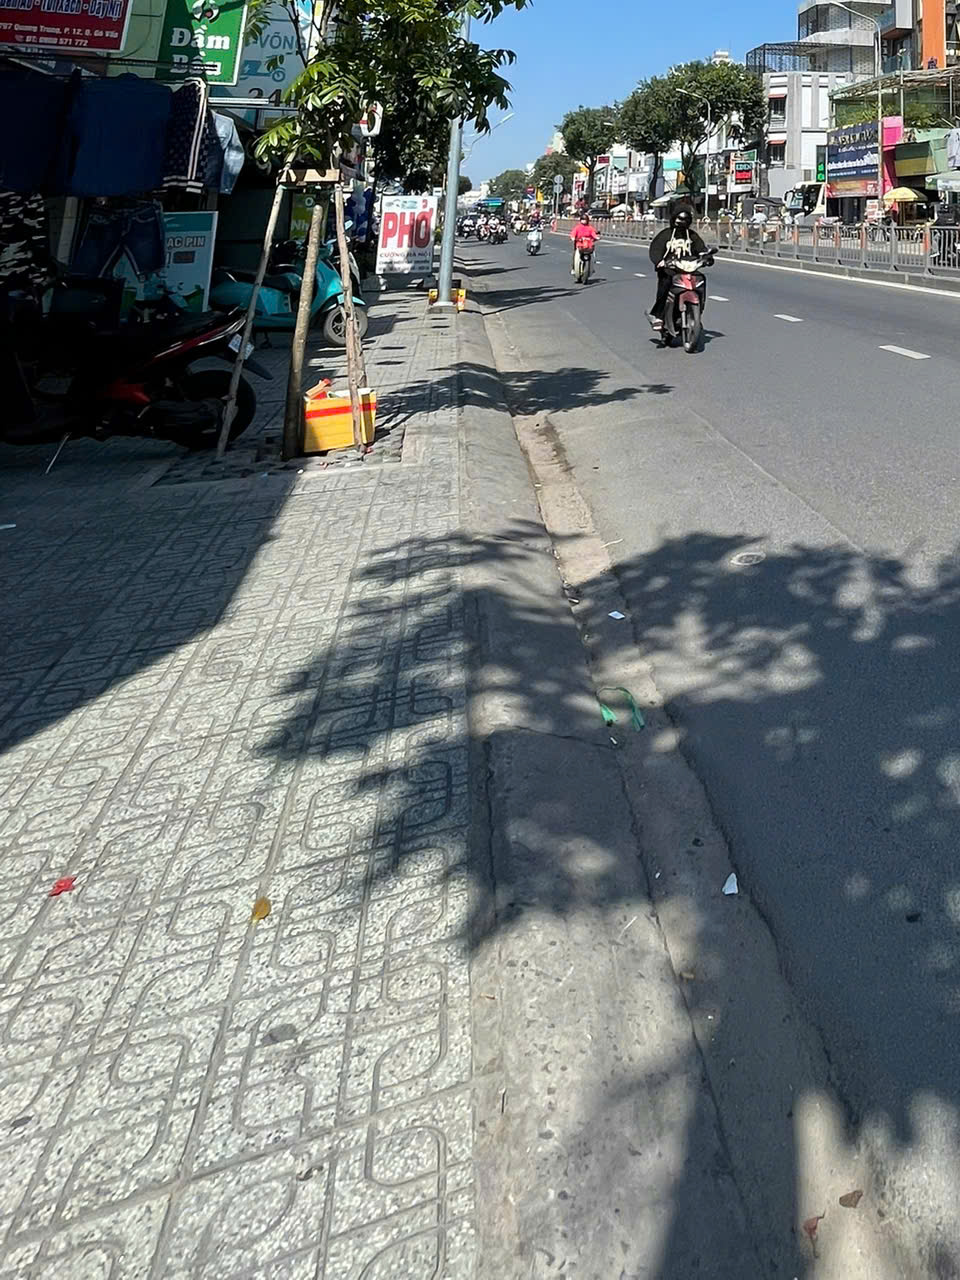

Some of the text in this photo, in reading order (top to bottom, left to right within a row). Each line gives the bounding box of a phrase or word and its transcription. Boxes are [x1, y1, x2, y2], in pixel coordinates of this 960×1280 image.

[169, 24, 231, 51] Đầm
[381, 199, 434, 249] PHỞ
[185, 235, 206, 248] PIN
